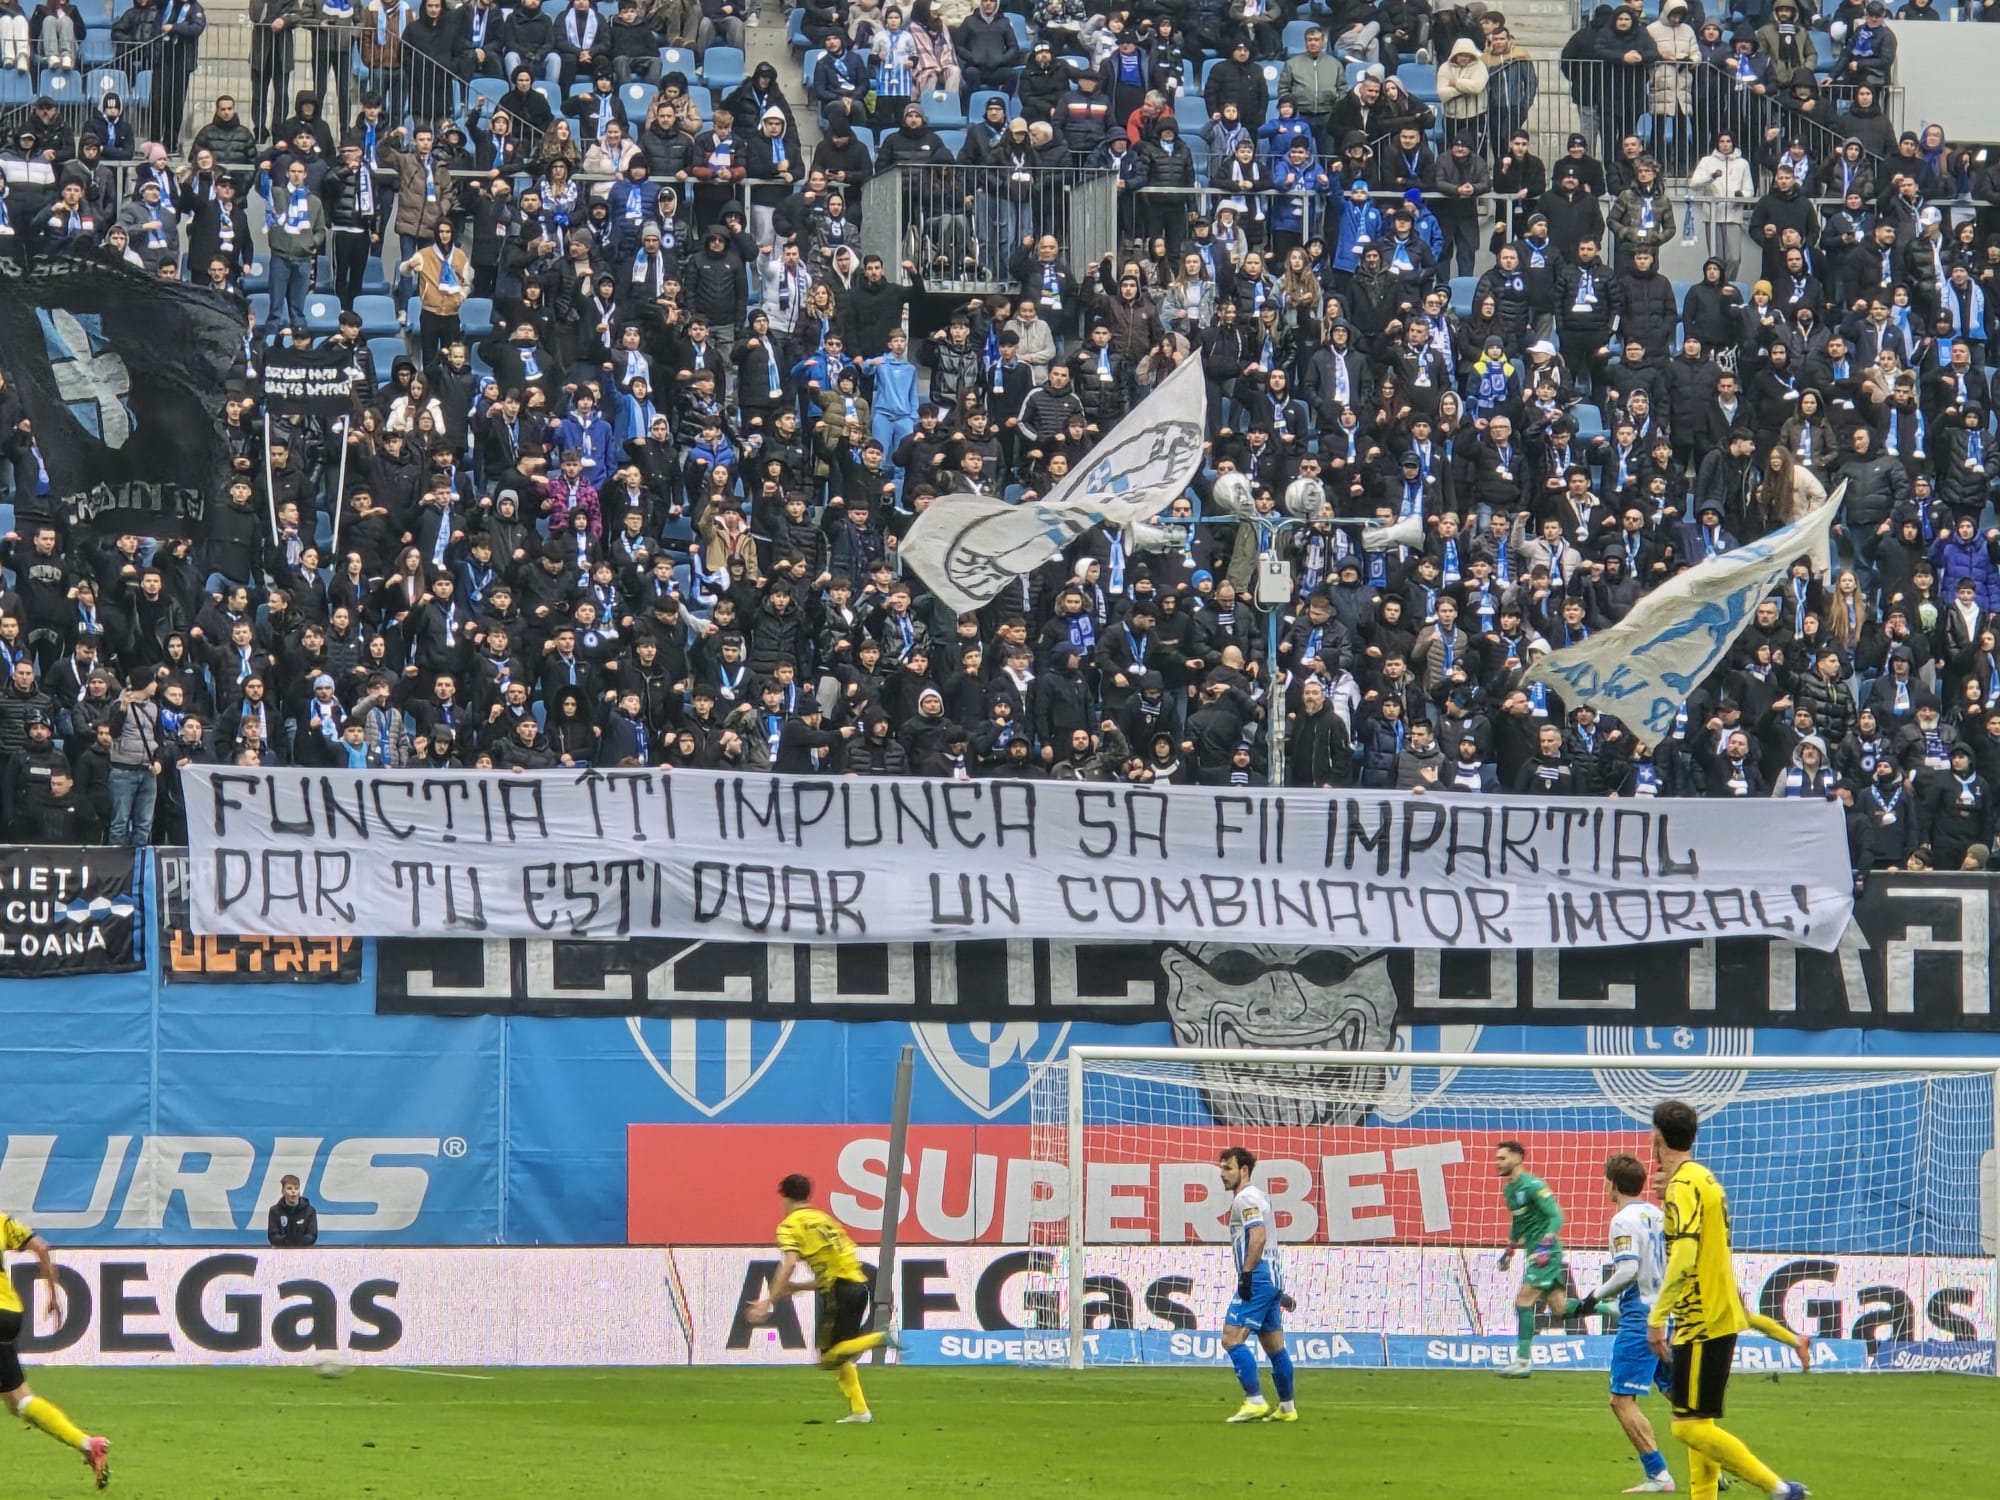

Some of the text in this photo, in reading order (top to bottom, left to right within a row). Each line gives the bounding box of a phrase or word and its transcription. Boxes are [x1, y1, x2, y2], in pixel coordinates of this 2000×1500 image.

[714, 776, 1037, 858] IMPUNEA
[1214, 795, 1285, 864] FII
[0, 866, 89, 899] IEȚI
[6, 901, 49, 924] CU
[214, 847, 356, 924] DAR
[391, 861, 489, 931] TU
[693, 861, 867, 935] DOAR
[929, 872, 1021, 926] UN
[1057, 873, 1513, 944] COMBINATOR
[1546, 884, 1811, 945] IMORAL!
[830, 1138, 1465, 1244] SUPERBET
[725, 1250, 1198, 1350] AEGas
[1427, 1339, 1585, 1365] SUPEBET
